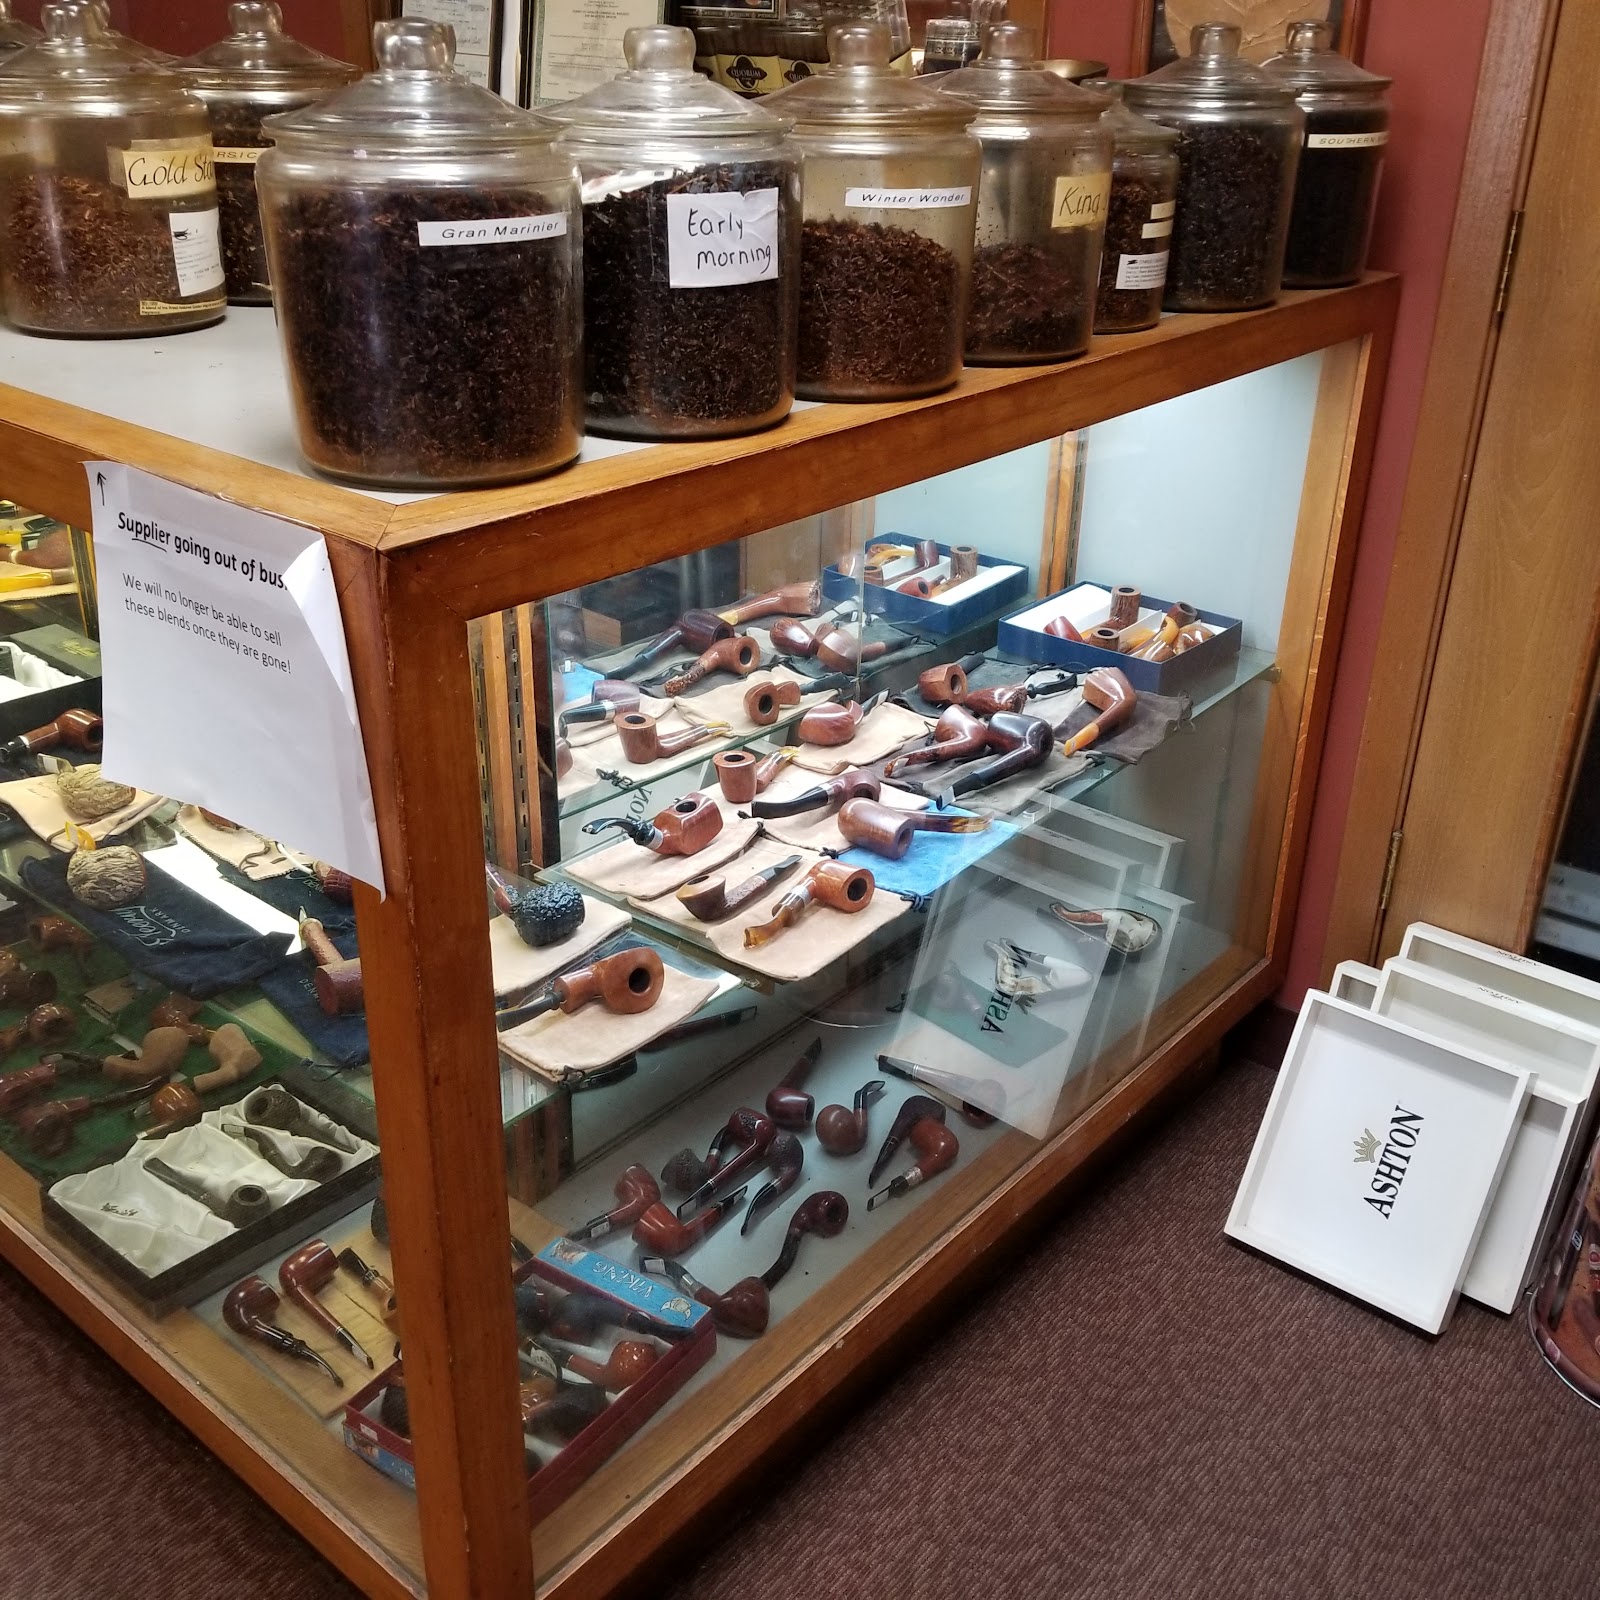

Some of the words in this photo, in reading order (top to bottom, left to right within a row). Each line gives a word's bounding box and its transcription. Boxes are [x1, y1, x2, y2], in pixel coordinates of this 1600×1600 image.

[731, 69, 761, 77] QUORUM
[128, 156, 188, 186] Gold
[194, 153, 213, 183] Sta
[217, 151, 257, 159] RSIC
[862, 193, 915, 203] Winter
[919, 193, 965, 203] Wonder
[441, 228, 487, 239] Gran
[493, 221, 559, 236] Marinier
[688, 208, 743, 240] Early
[697, 244, 771, 274] morning
[118, 512, 171, 545] Supplier
[174, 535, 210, 564] going
[214, 551, 237, 571] out
[241, 559, 256, 582] of
[259, 562, 288, 590] bus
[122, 573, 142, 590] We
[144, 582, 163, 598] will
[164, 588, 177, 603] no
[178, 591, 209, 616] longer
[211, 605, 225, 622] be
[226, 613, 249, 633] able
[250, 623, 262, 638] to
[264, 630, 282, 647] sell
[124, 597, 155, 618] these
[157, 606, 191, 631] blends
[192, 624, 216, 642] once
[217, 631, 240, 655] they
[242, 644, 260, 660] are
[262, 654, 292, 675] gone!
[150, 907, 191, 933] DENMARK
[1363, 1104, 1425, 1220] ASHTON
[592, 1260, 654, 1298] VIKING
